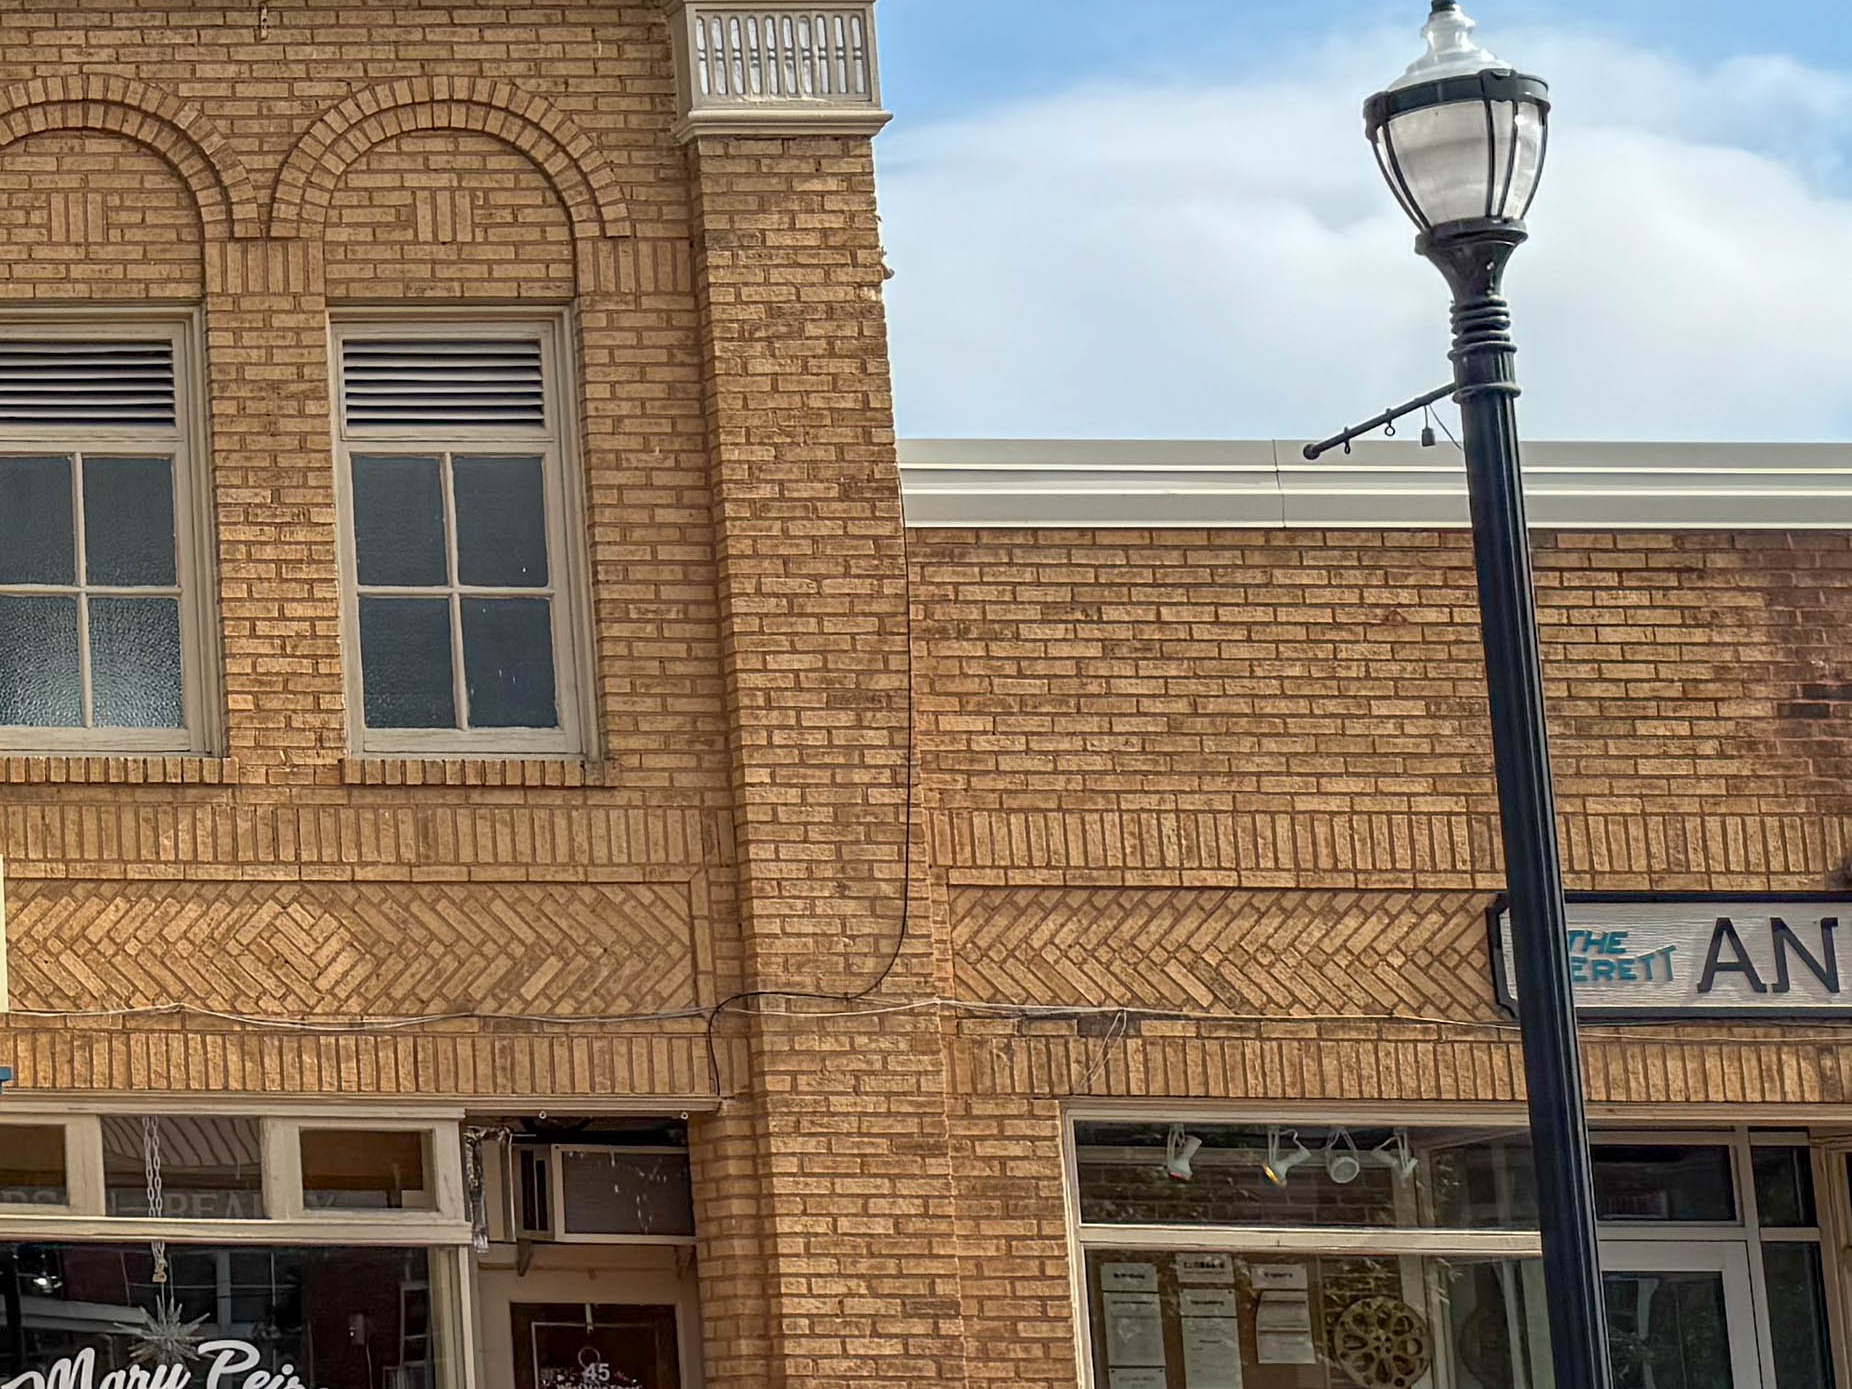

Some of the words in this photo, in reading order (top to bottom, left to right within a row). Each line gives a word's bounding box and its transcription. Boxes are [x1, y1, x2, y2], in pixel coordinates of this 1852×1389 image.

[1567, 930, 1629, 955] THE
[1570, 945, 1677, 983] ERETT
[585, 1362, 610, 1381] 45
